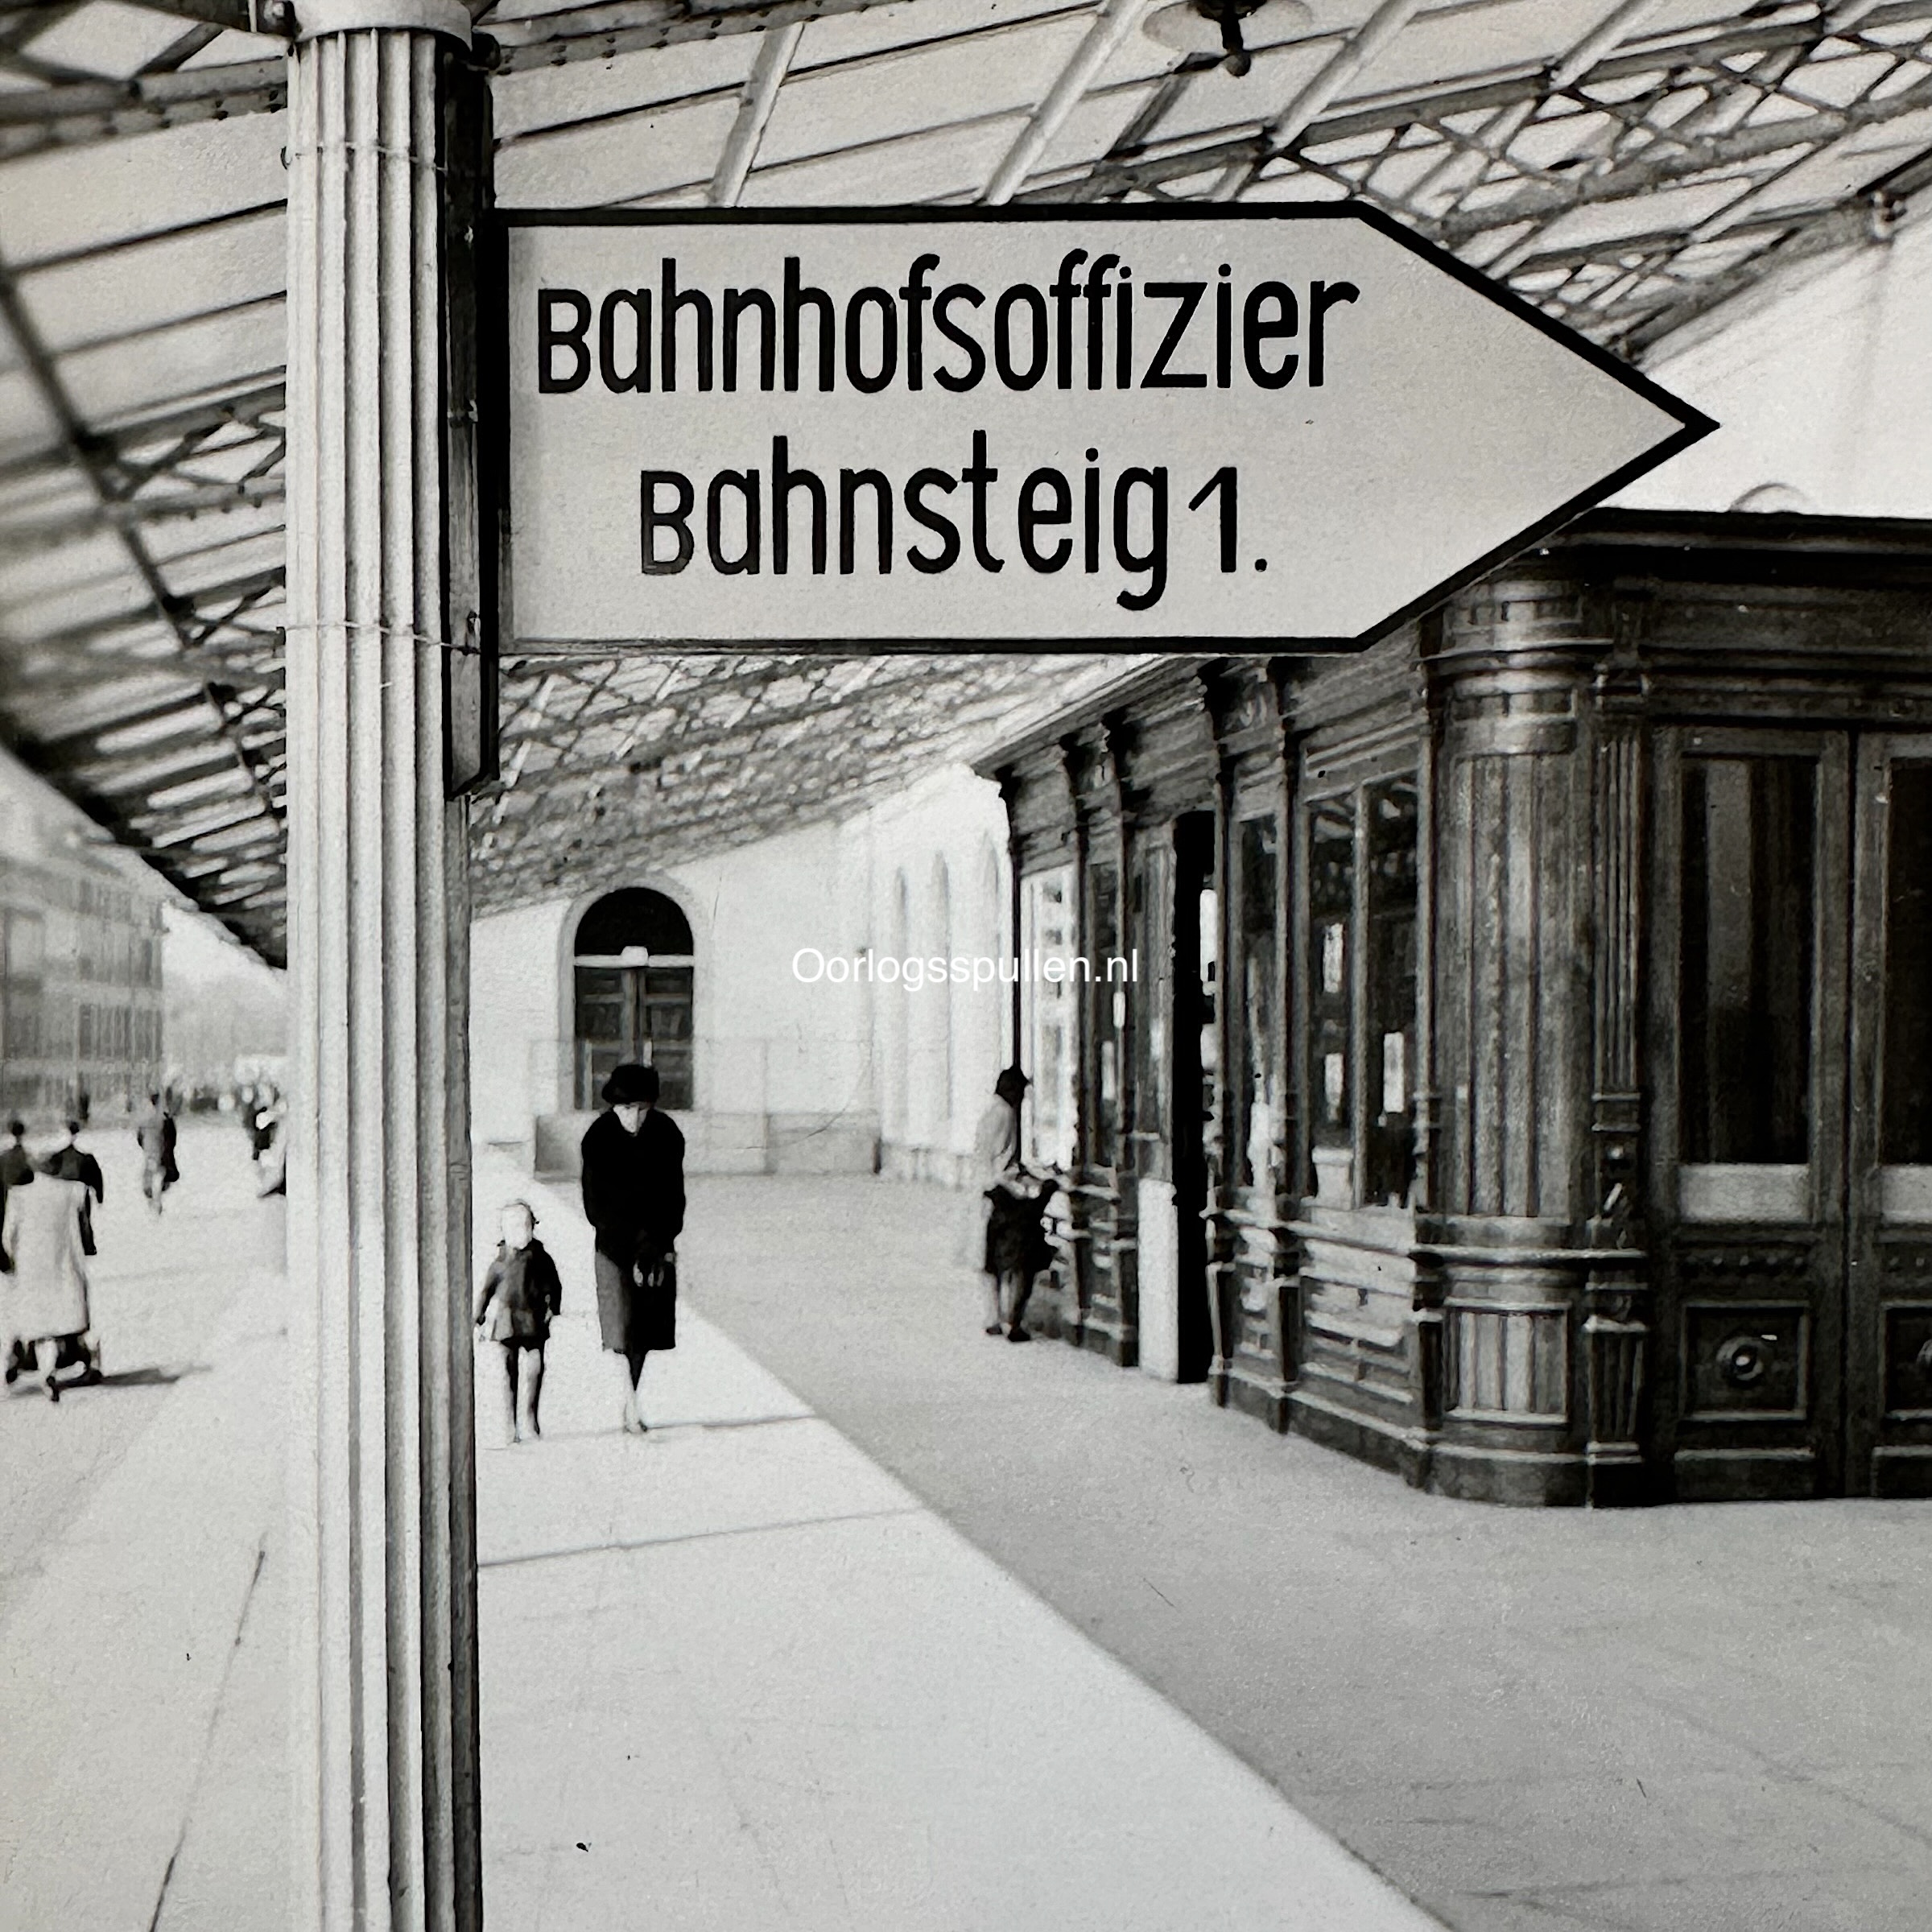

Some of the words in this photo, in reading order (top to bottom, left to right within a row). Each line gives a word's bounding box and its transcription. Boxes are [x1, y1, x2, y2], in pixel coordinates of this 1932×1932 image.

[537, 249, 1360, 394] Bahnhofsoffizier
[640, 430, 1168, 612] Bahnsteig
[1188, 466, 1268, 573] 1.
